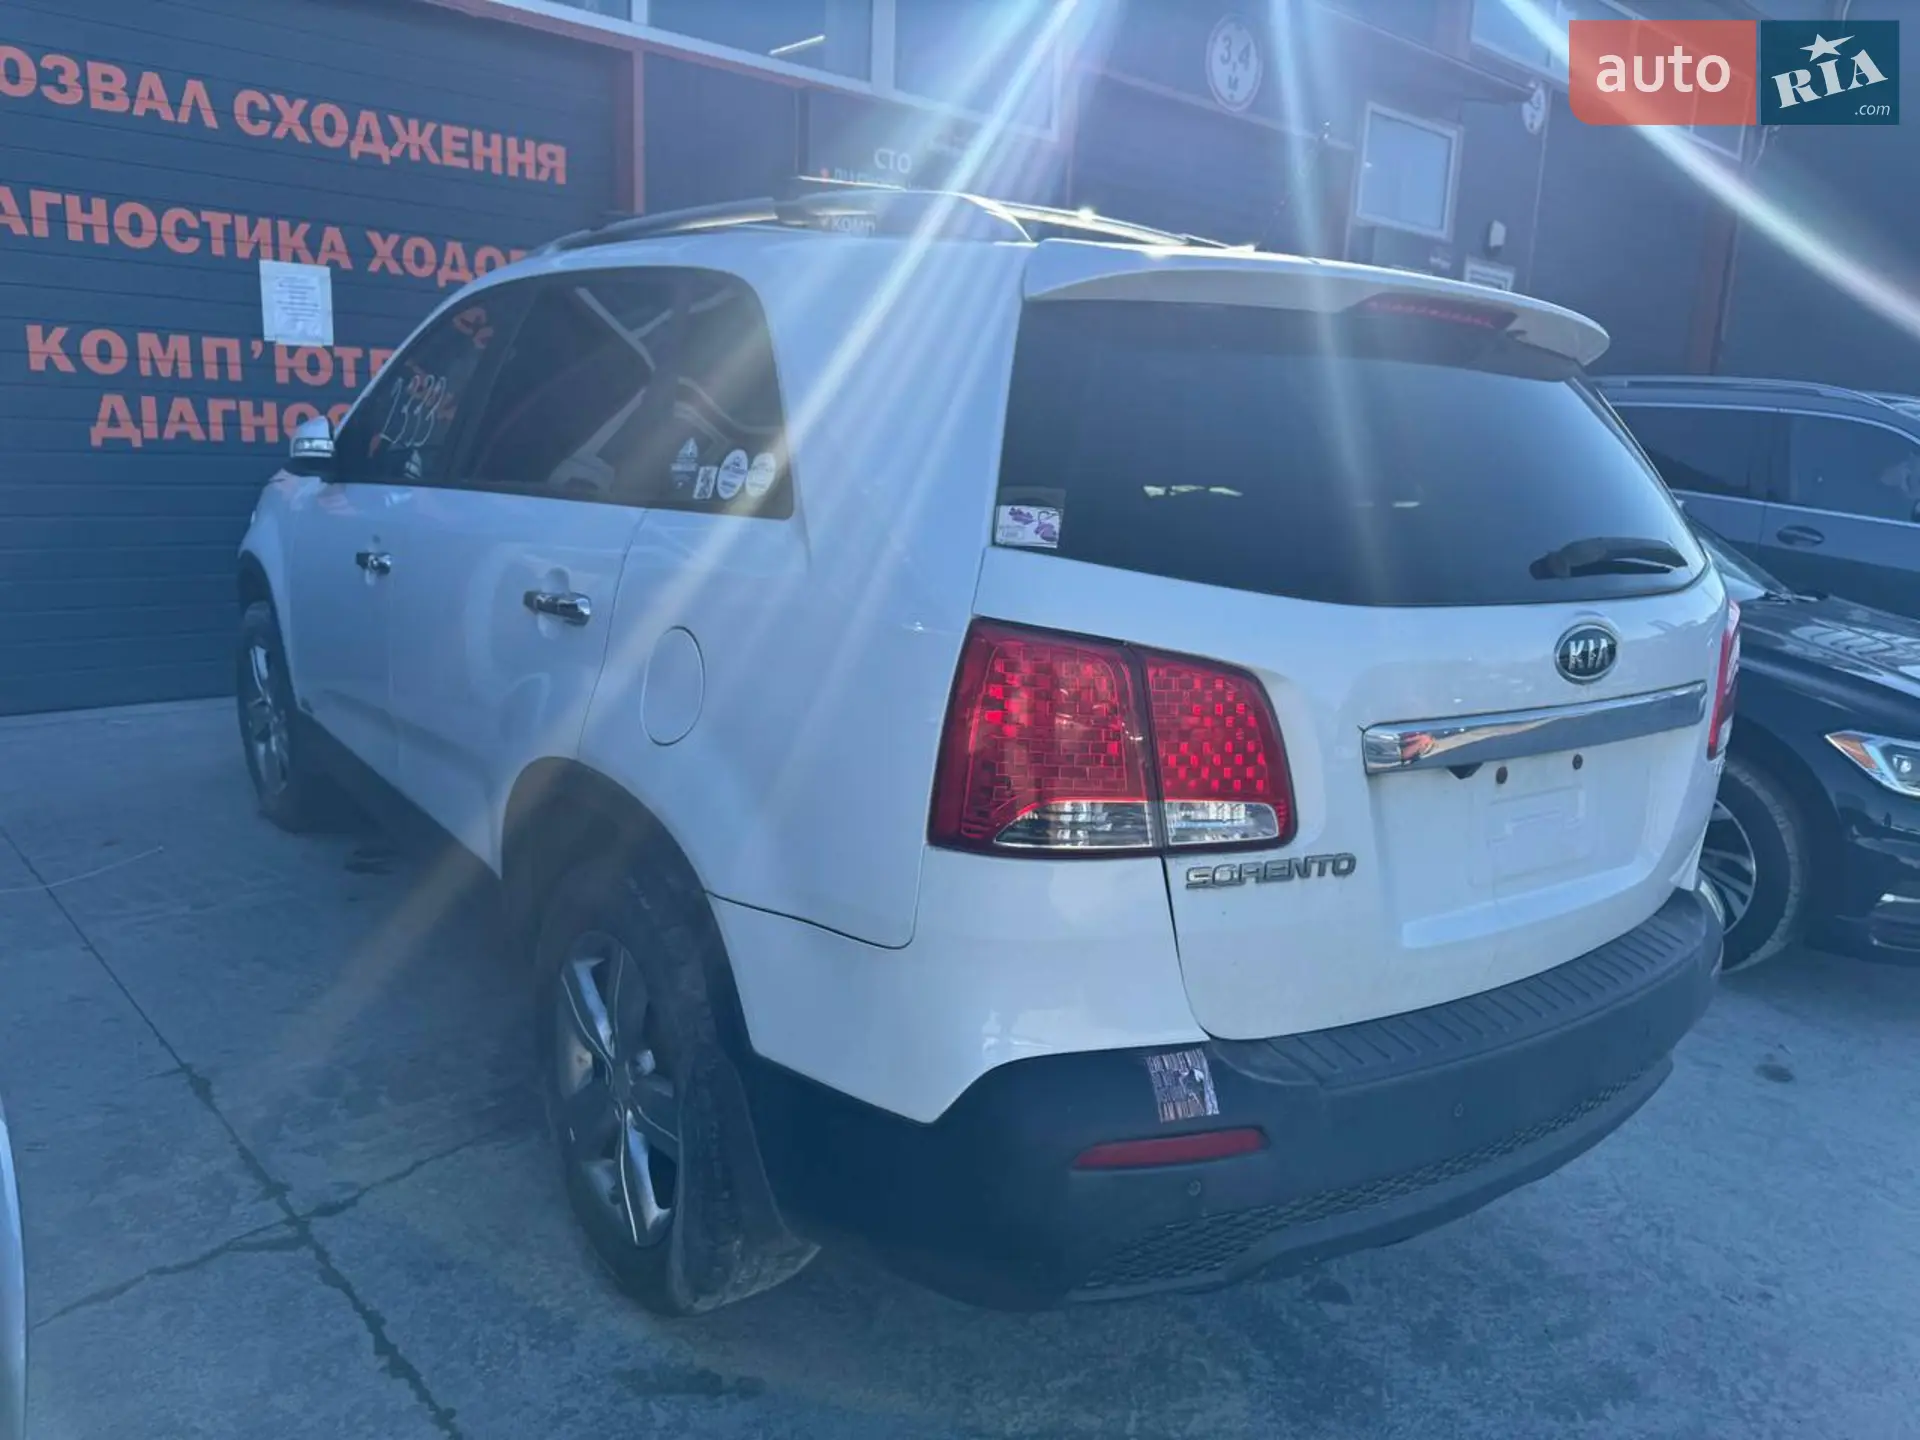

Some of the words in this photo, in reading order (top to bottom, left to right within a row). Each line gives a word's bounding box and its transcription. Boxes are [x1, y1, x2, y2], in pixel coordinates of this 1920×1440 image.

[0, 45, 219, 130] ОЗВАЛ
[233, 89, 567, 185] СХОДЖЕННЯ
[366, 229, 527, 289] ХОДО
[1568, 638, 1610, 672] KIA
[1186, 853, 1356, 889] SORENTO
